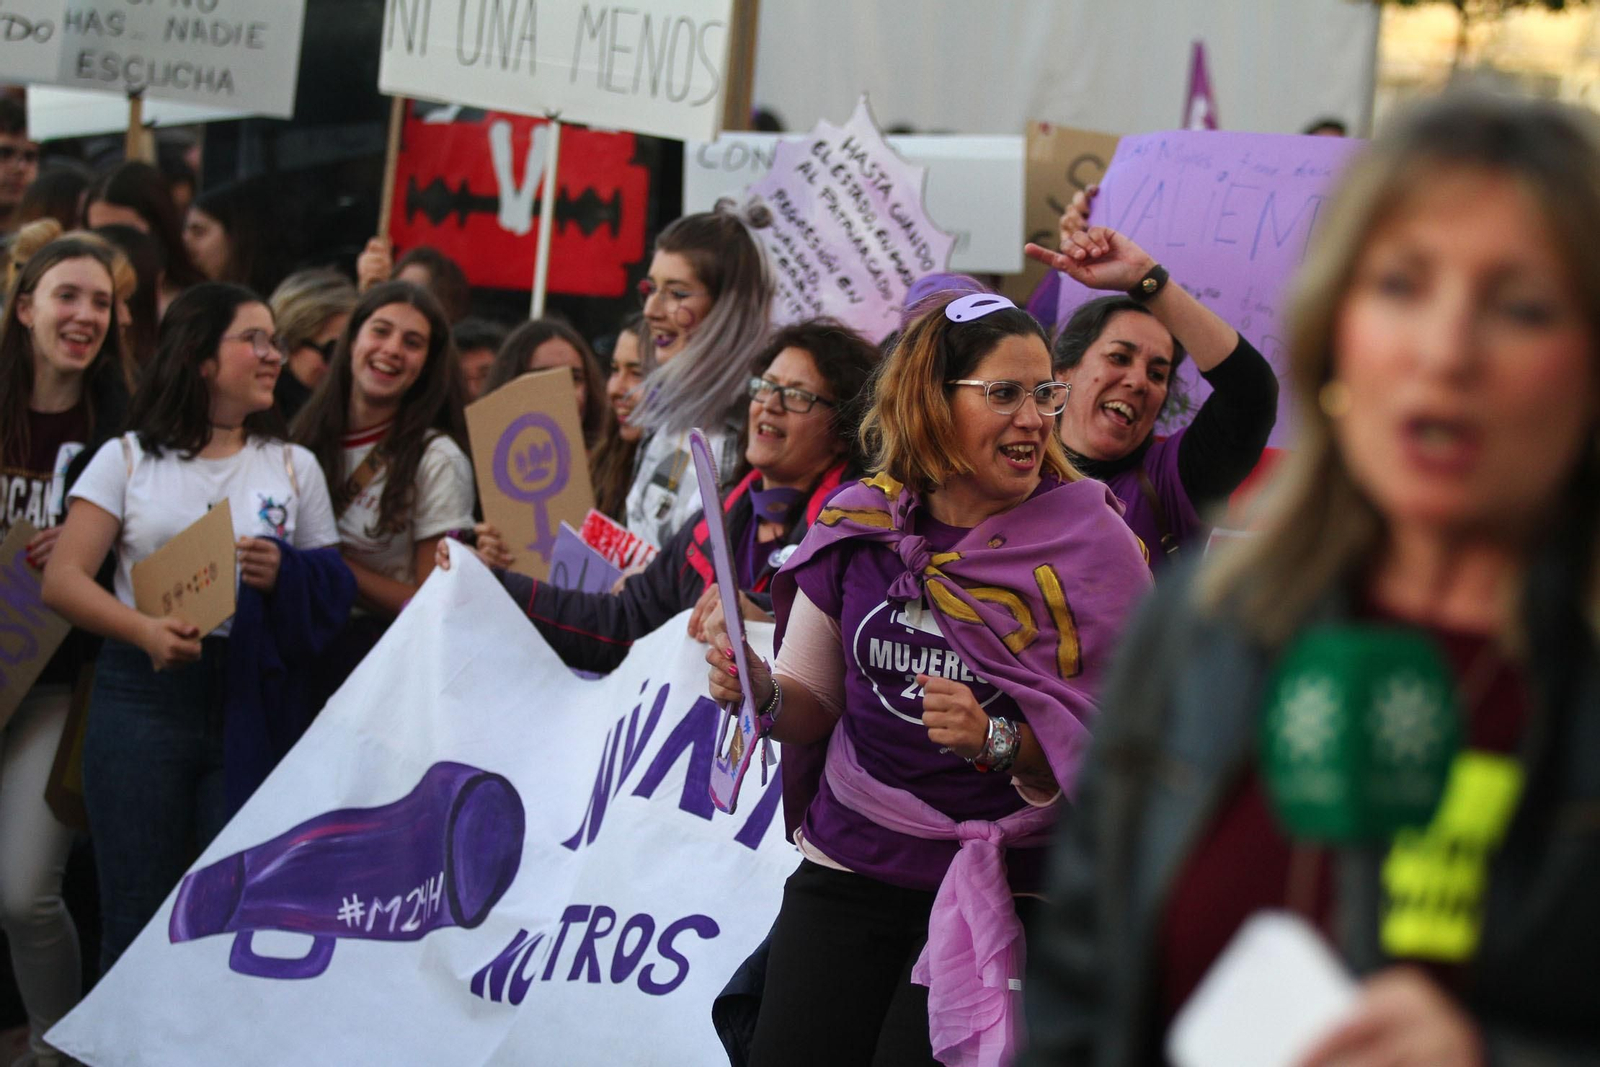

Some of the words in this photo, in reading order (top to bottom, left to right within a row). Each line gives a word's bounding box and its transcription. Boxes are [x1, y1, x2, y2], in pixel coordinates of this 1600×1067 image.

[163, 16, 269, 50] NADIE
[386, 0, 430, 57] NI
[456, 0, 538, 76] UNA
[569, 3, 726, 107] MENOS
[75, 50, 236, 96] ESCUCHA
[811, 139, 833, 167] EL
[794, 160, 819, 187] AL
[840, 135, 895, 201] HASTA
[888, 203, 936, 272] CUANDO
[837, 275, 863, 305] EN
